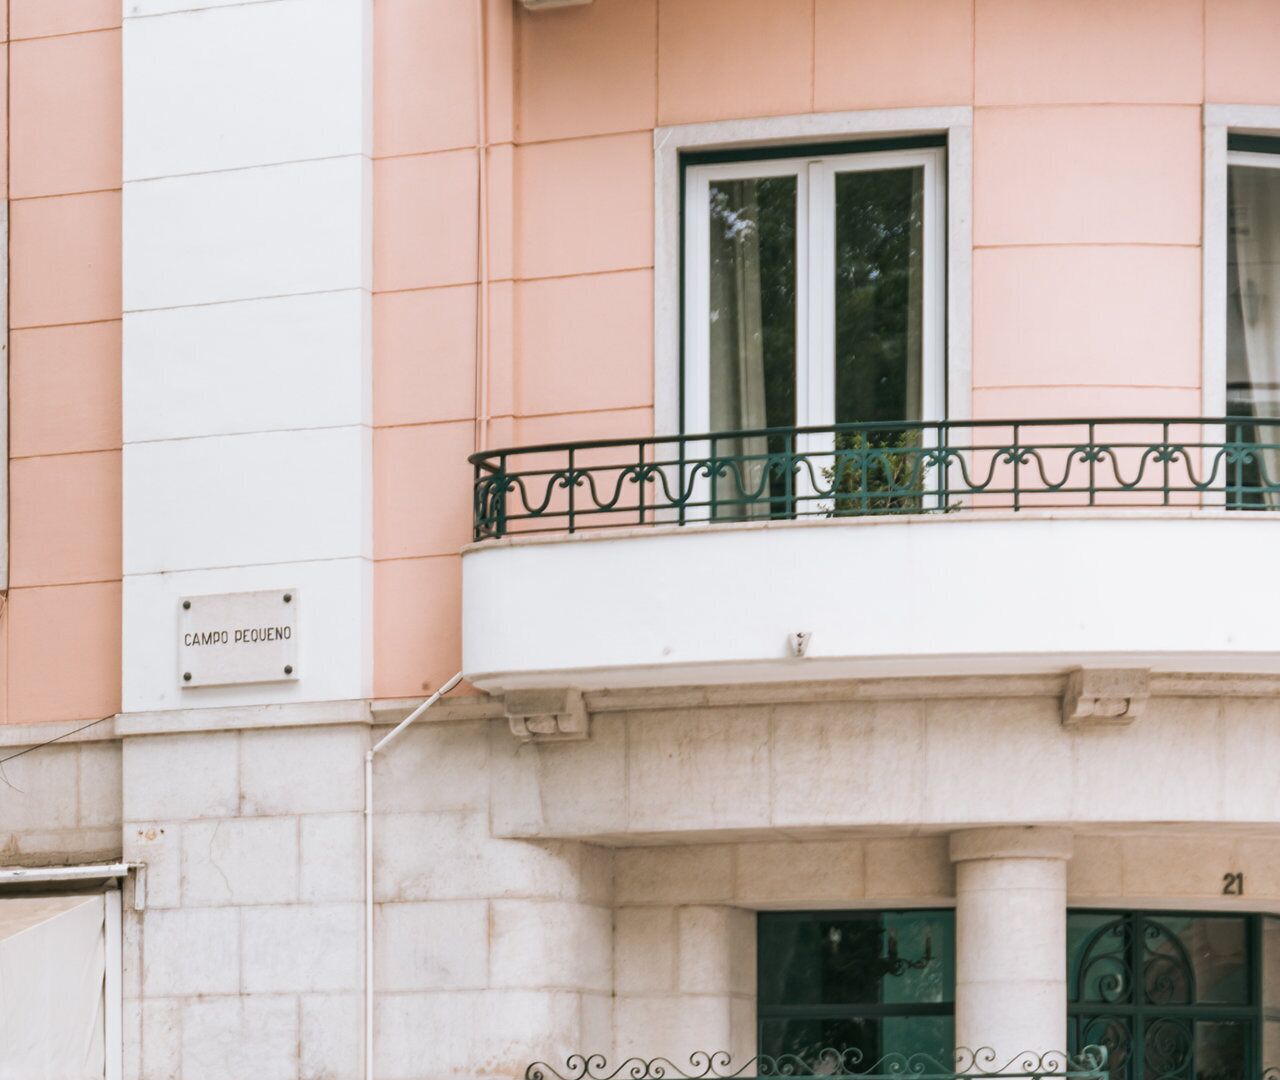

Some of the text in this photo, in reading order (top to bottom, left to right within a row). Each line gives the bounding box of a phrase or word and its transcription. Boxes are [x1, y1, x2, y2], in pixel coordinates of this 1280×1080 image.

[184, 625, 292, 647] CAMPO PEQUENO
[1223, 871, 1244, 896] 21
